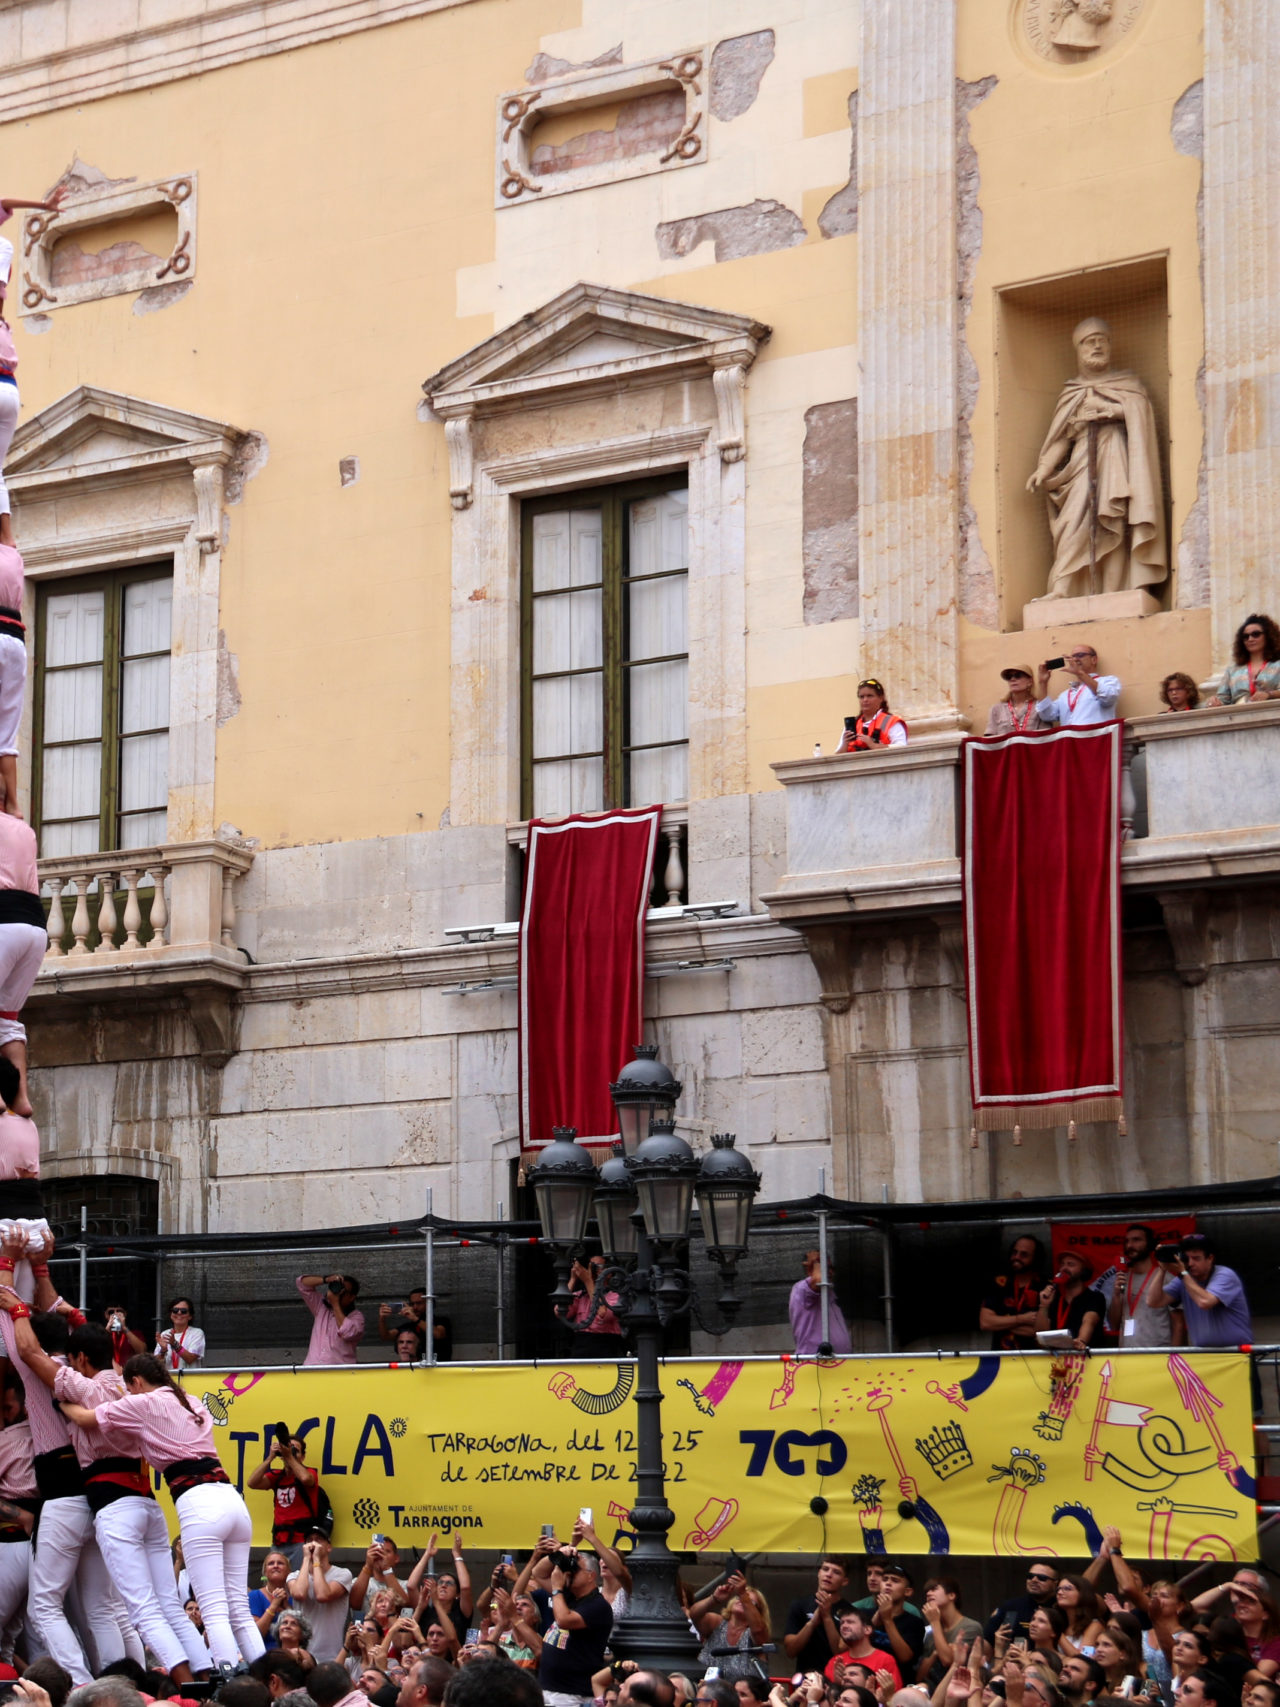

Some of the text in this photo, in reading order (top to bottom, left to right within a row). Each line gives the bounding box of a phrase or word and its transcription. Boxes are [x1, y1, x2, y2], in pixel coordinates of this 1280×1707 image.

[615, 1429, 638, 1452] 12
[672, 1430, 704, 1452] 25
[441, 1460, 468, 1483] de
[628, 1461, 687, 1482] 222
